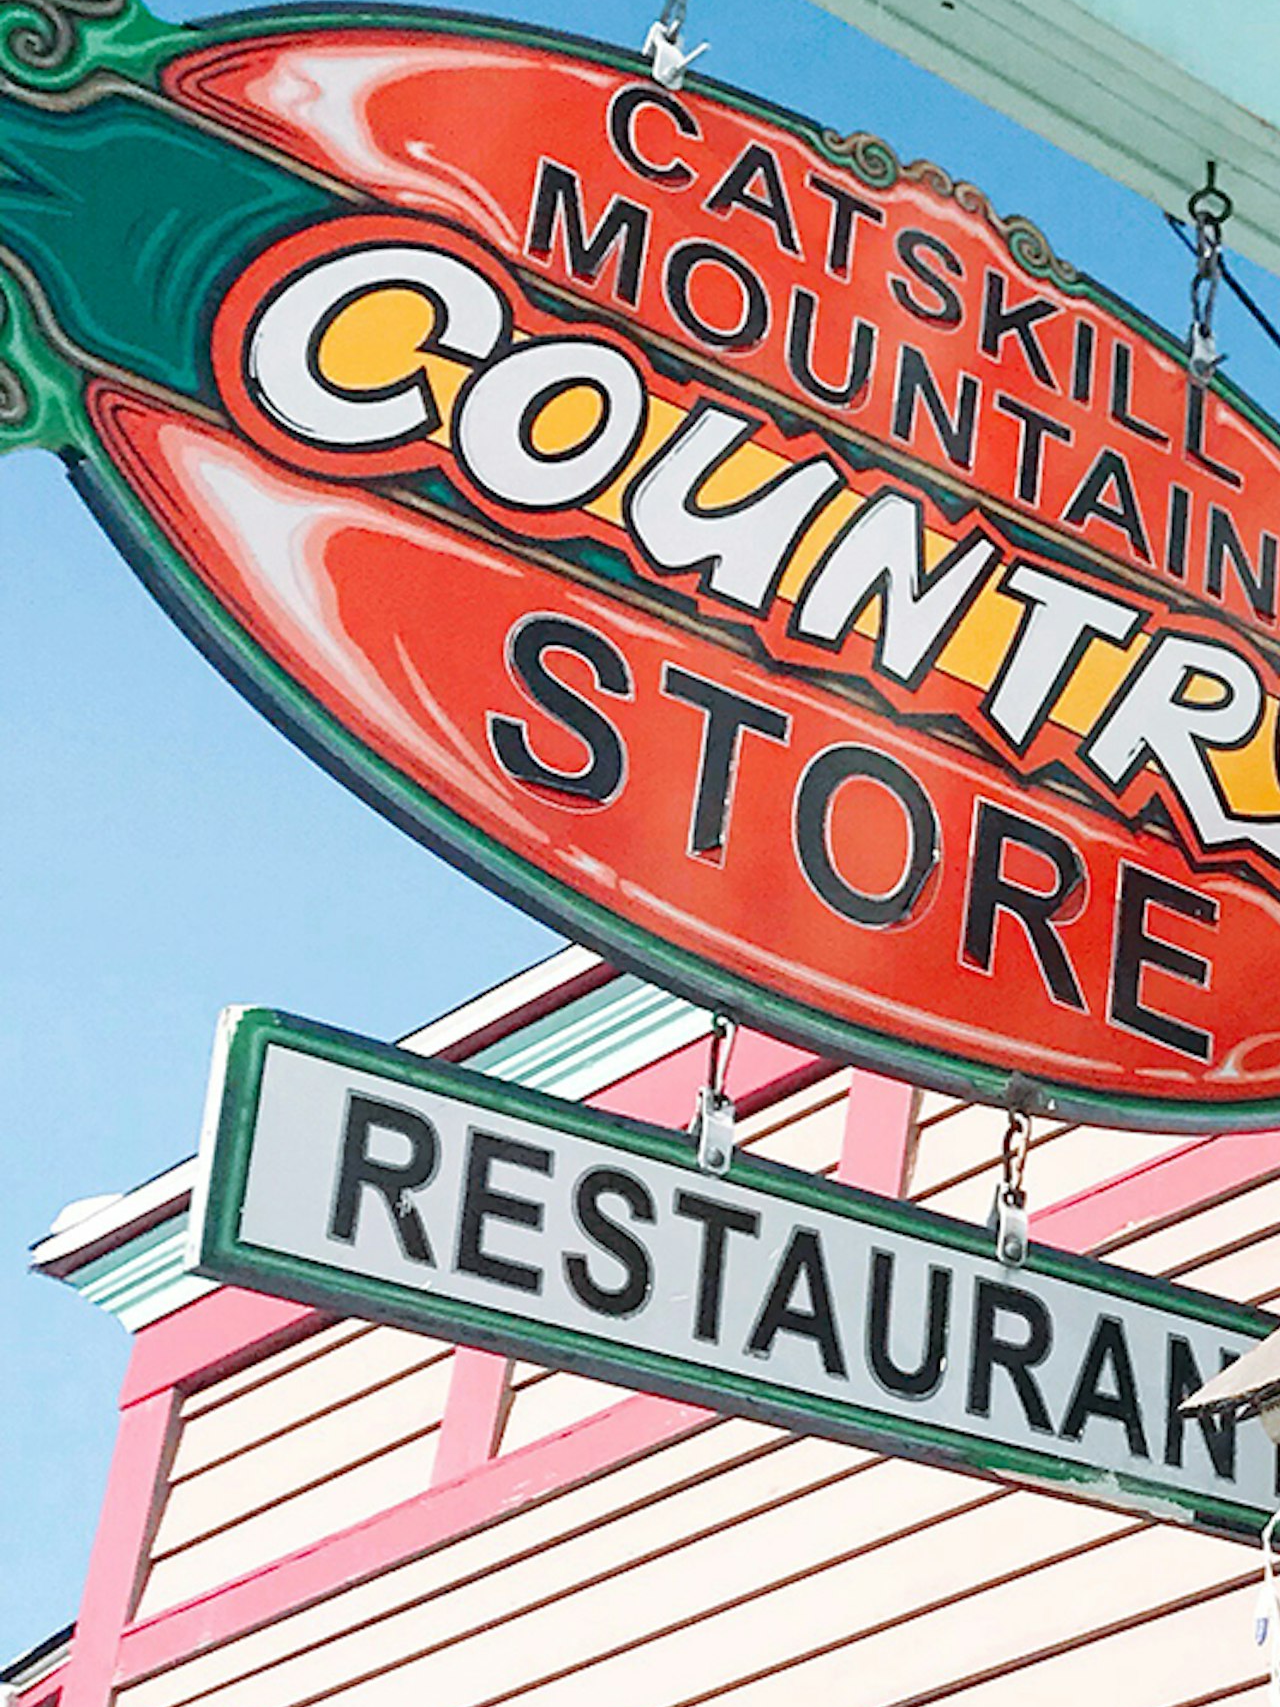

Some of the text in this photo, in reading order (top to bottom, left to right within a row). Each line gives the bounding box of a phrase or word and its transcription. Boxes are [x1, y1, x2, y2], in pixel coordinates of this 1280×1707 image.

[526, 156, 1278, 622] MOUNTAIN
[606, 79, 1245, 488] CATSKILL
[490, 614, 1218, 1060] STORE
